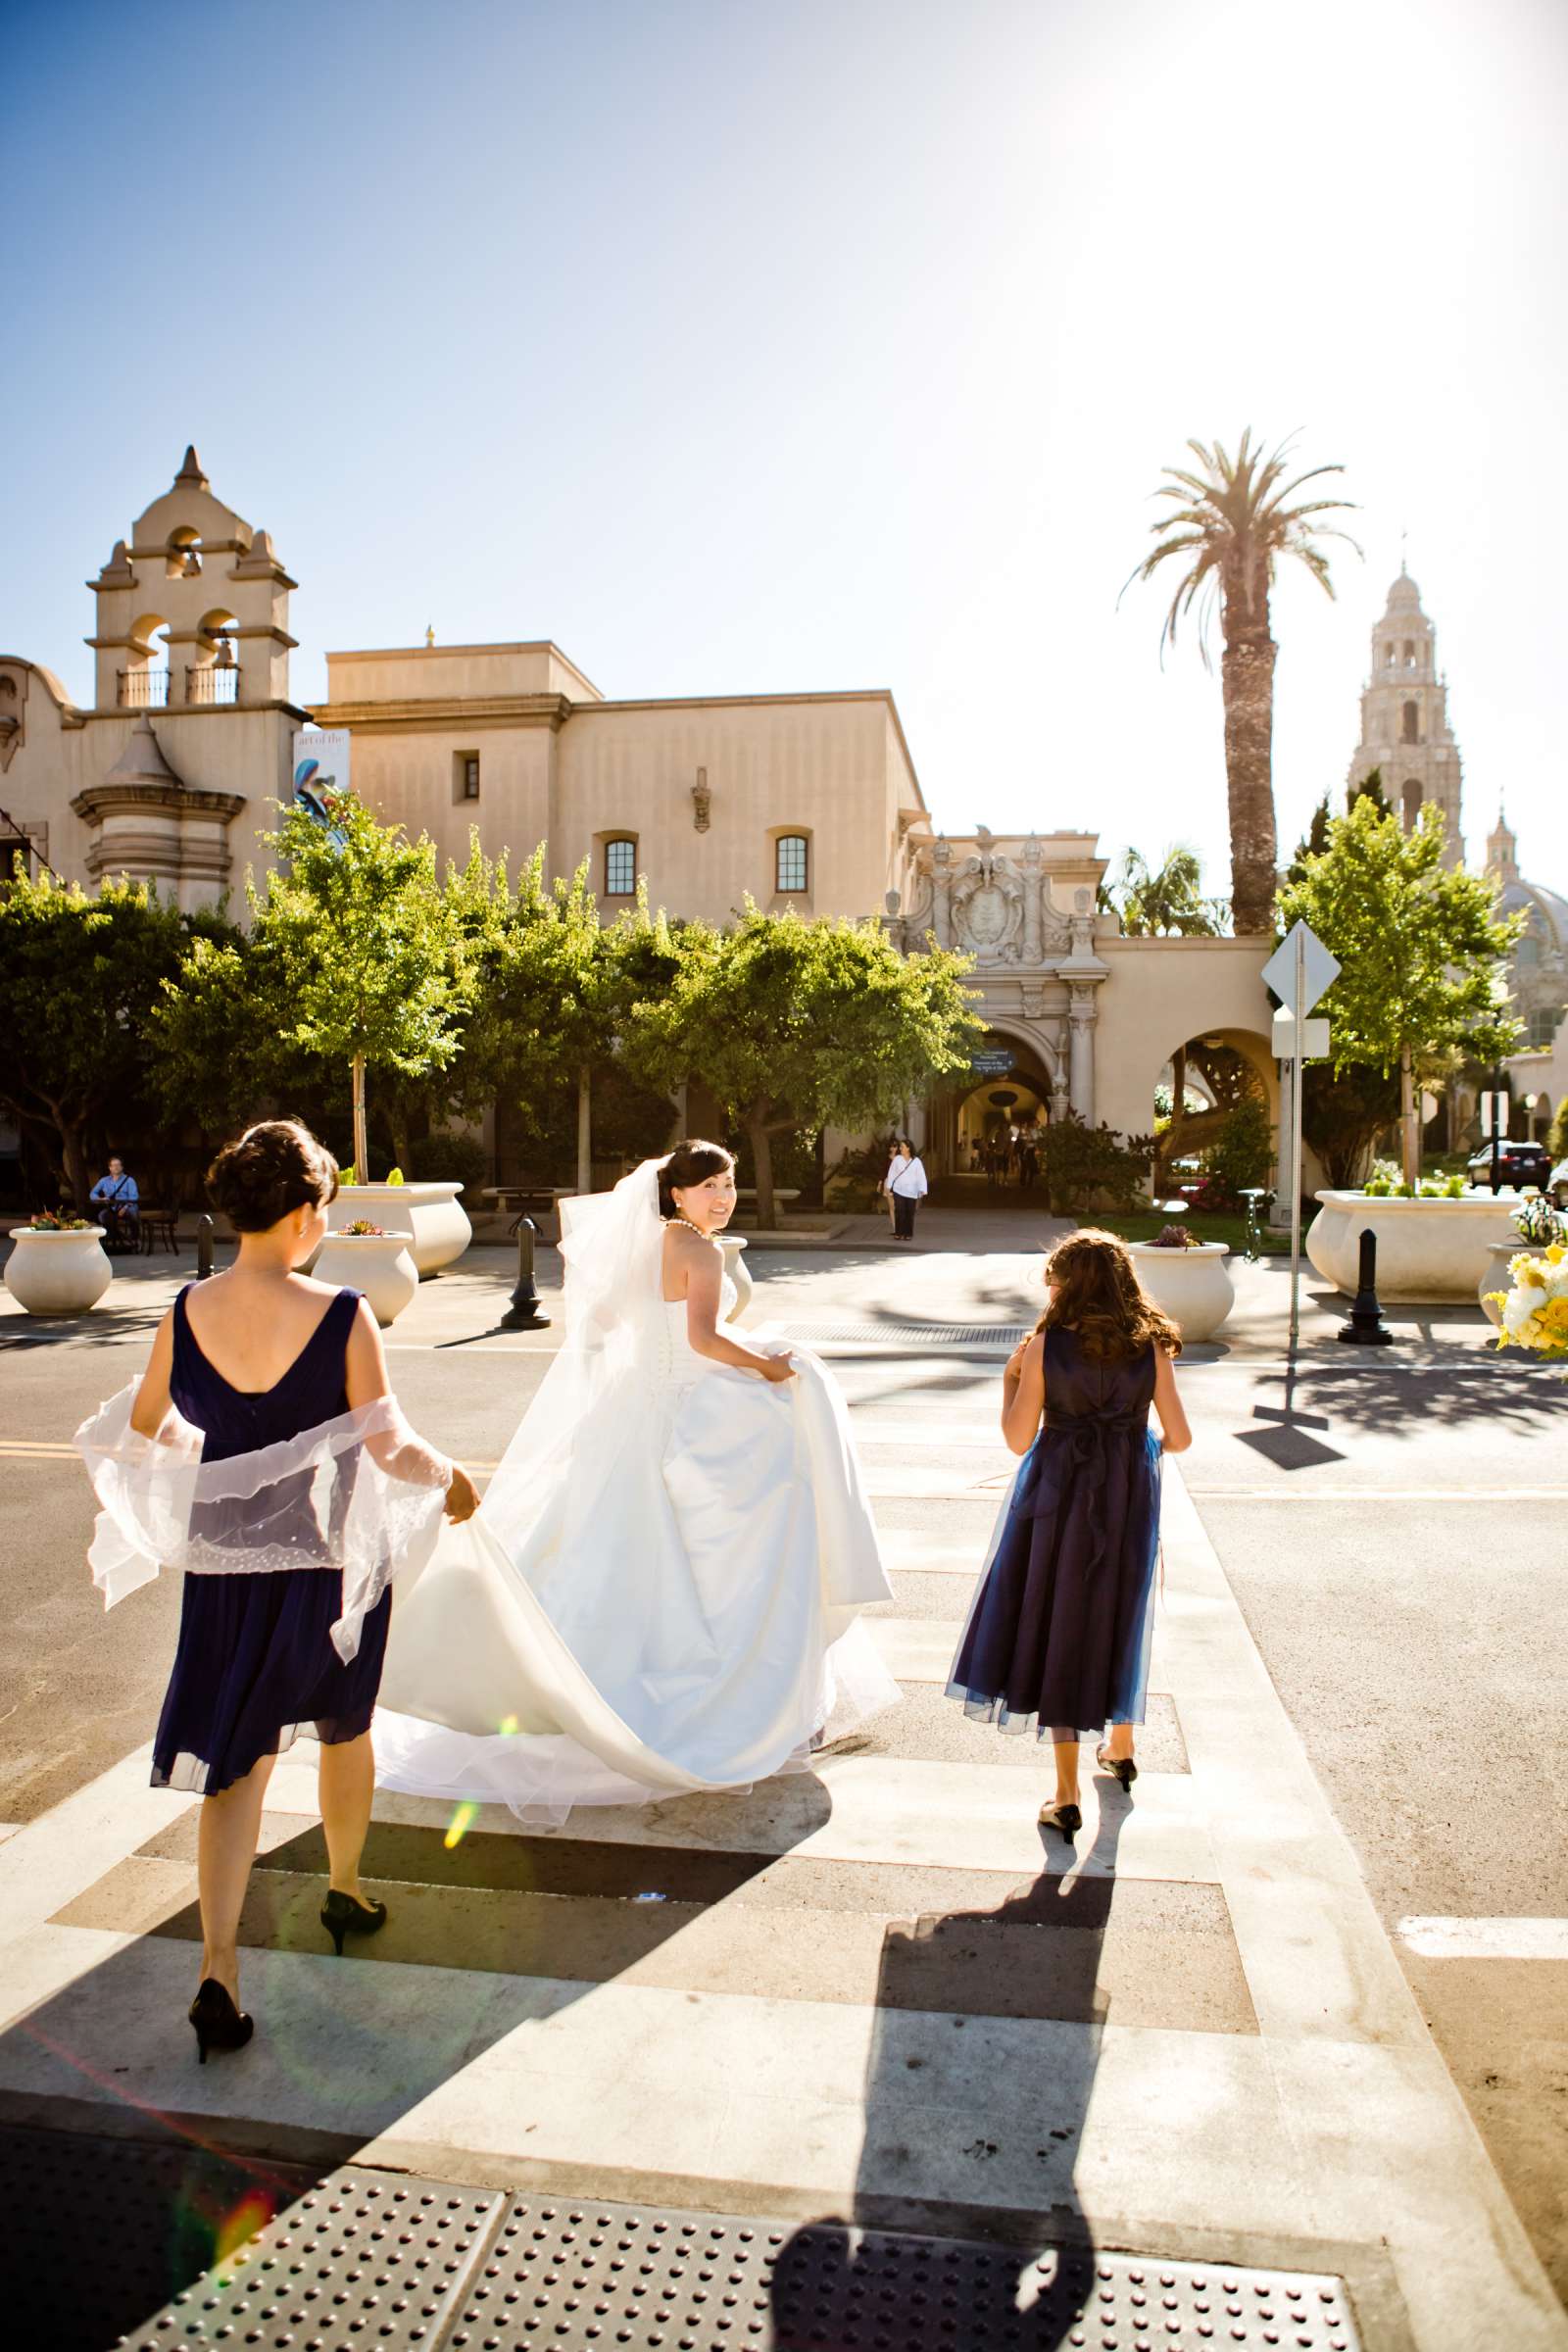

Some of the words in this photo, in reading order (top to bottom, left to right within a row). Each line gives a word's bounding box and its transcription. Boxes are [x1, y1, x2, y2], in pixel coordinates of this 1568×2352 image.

[299, 736, 314, 746] art
[315, 733, 325, 746] of
[328, 733, 345, 746] the
